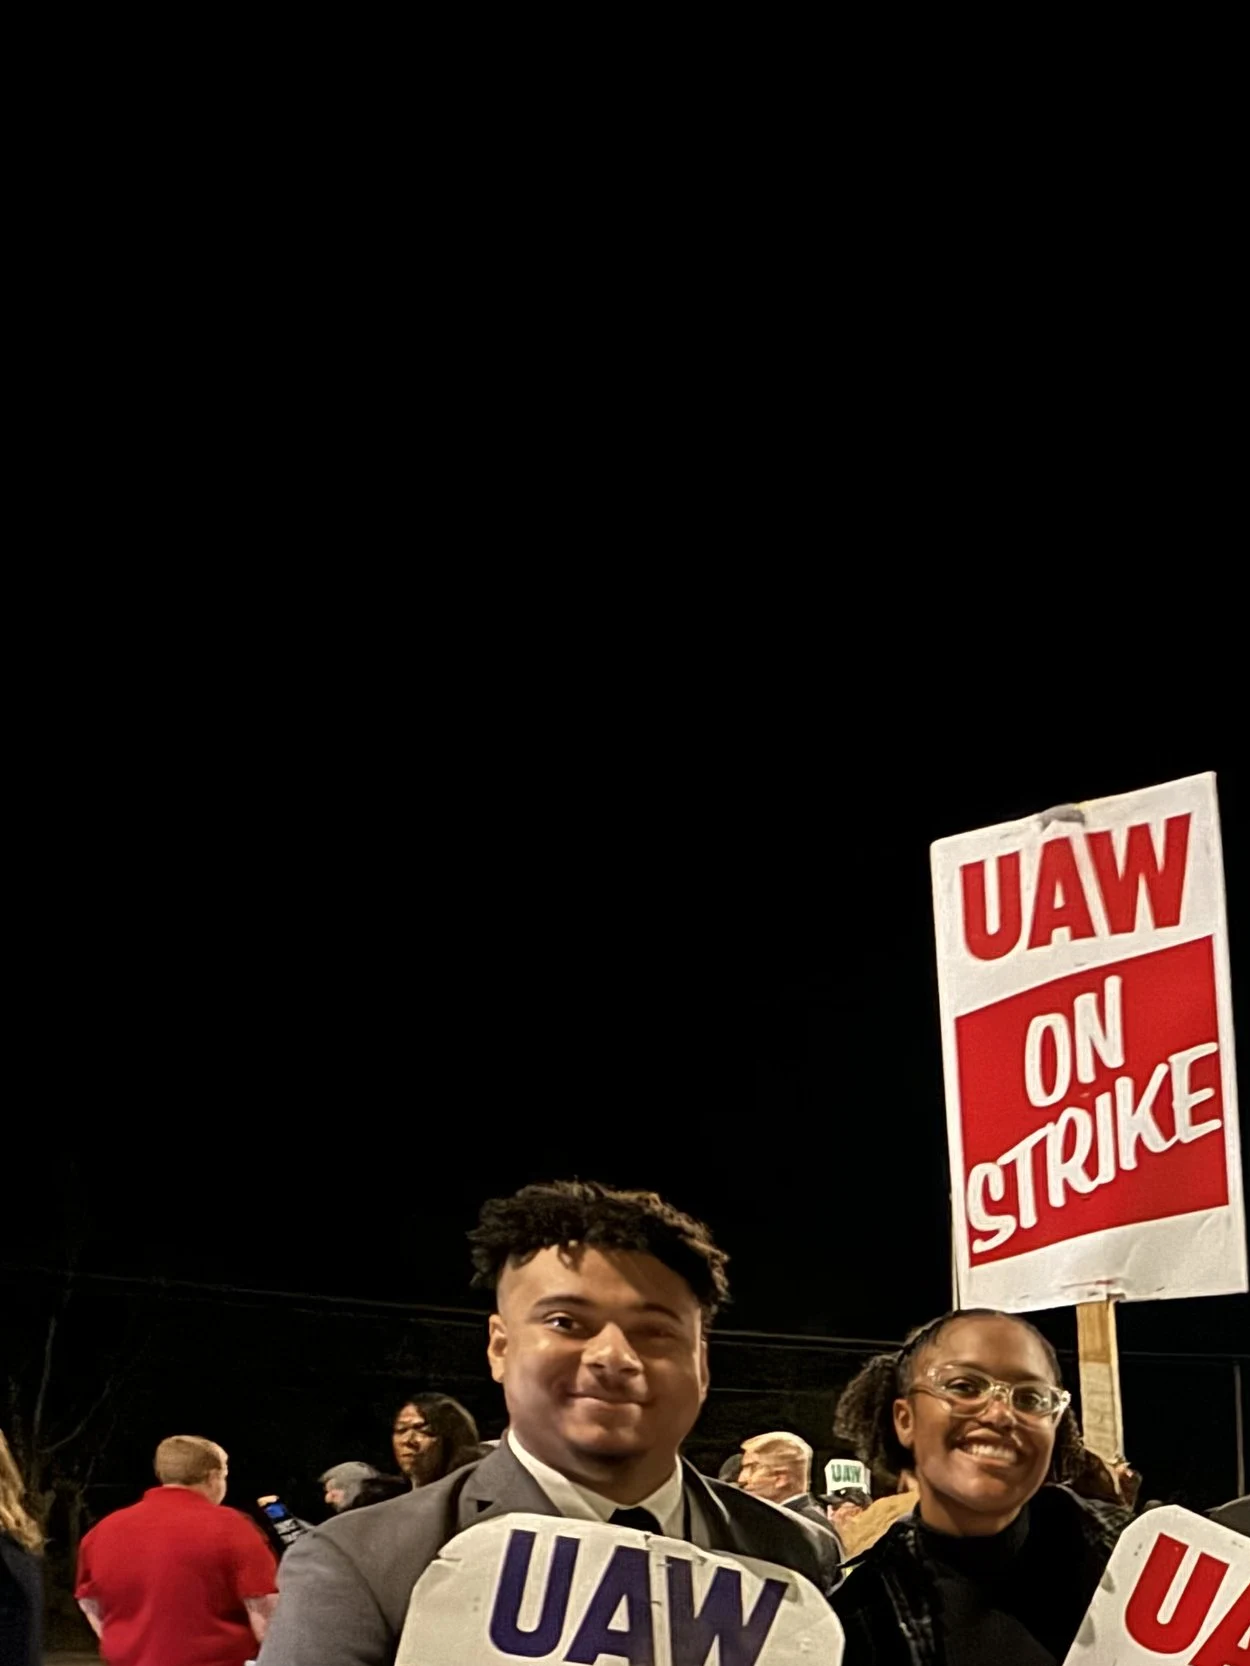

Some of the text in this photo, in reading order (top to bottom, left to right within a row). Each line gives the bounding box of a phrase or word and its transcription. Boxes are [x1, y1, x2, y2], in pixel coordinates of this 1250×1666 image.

[959, 812, 1192, 961] UAW
[1024, 975, 1124, 1107] ON
[967, 1042, 1222, 1254] STRIKE
[831, 1464, 862, 1483] UAW
